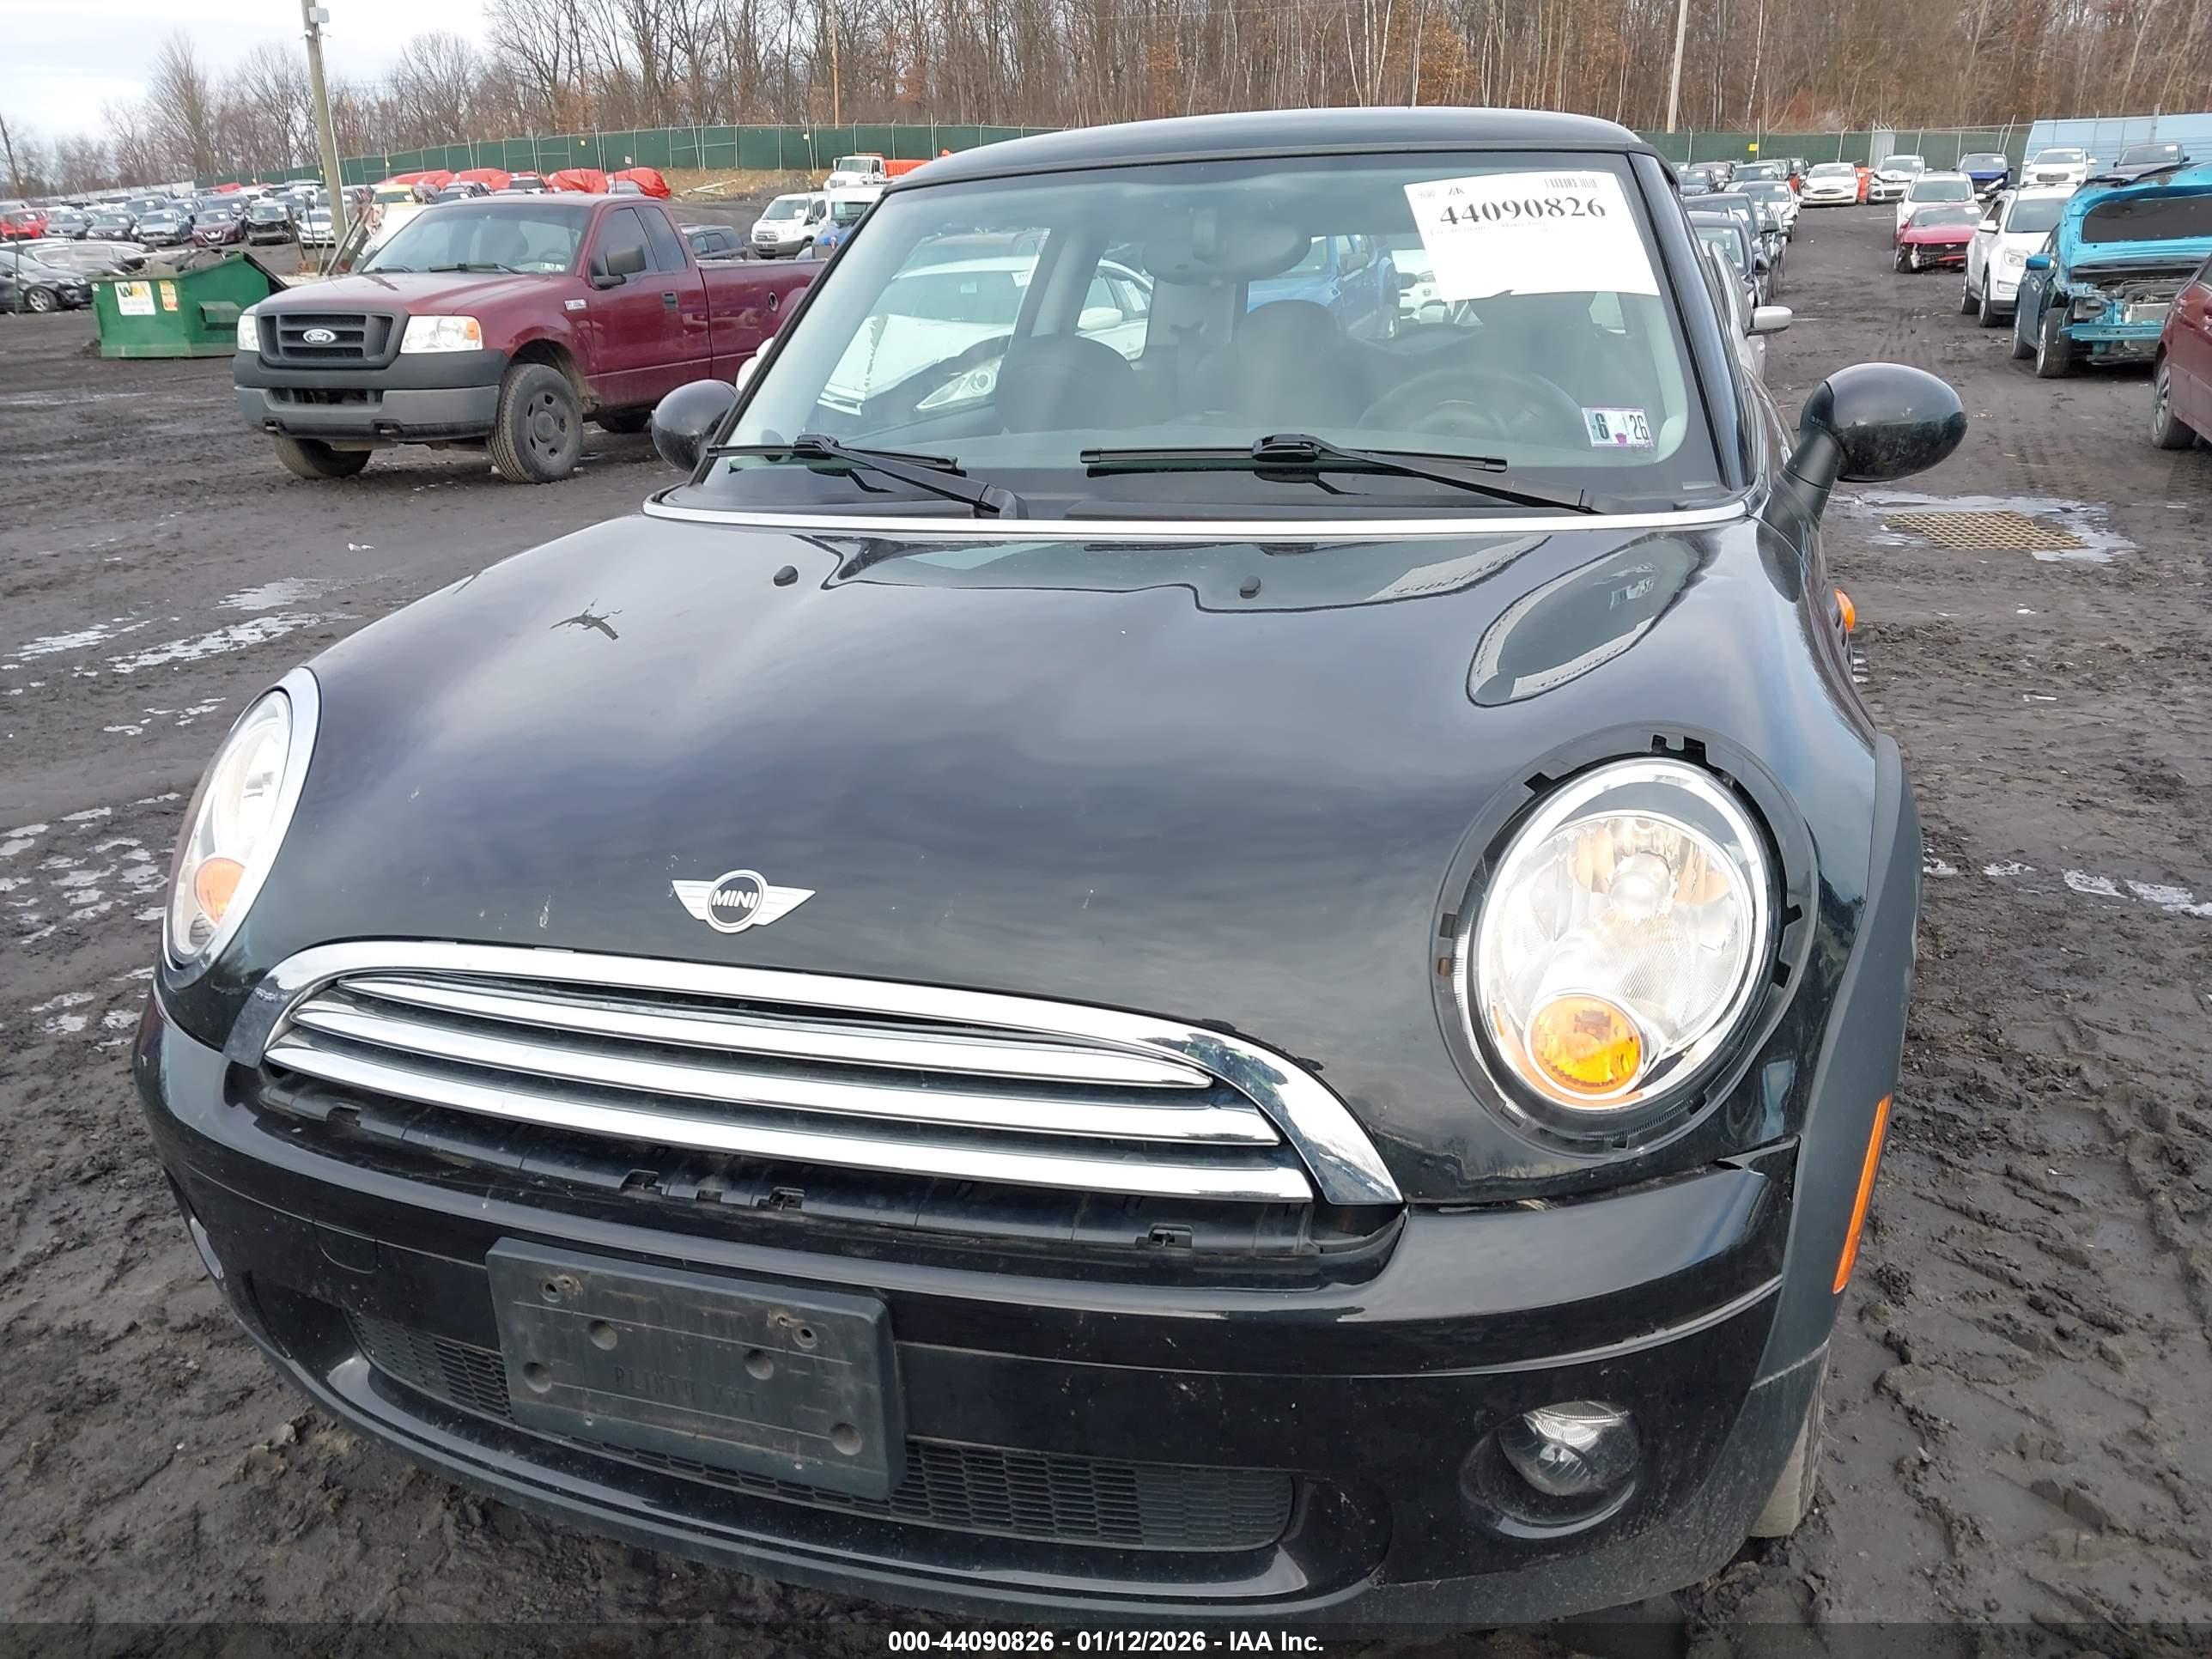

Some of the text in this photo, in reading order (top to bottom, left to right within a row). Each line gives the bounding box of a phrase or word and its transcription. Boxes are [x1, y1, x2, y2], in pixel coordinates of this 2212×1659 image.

[1440, 197, 1606, 225] 44090826
[1595, 412, 1650, 441] 6 26
[711, 890, 758, 908] MINI
